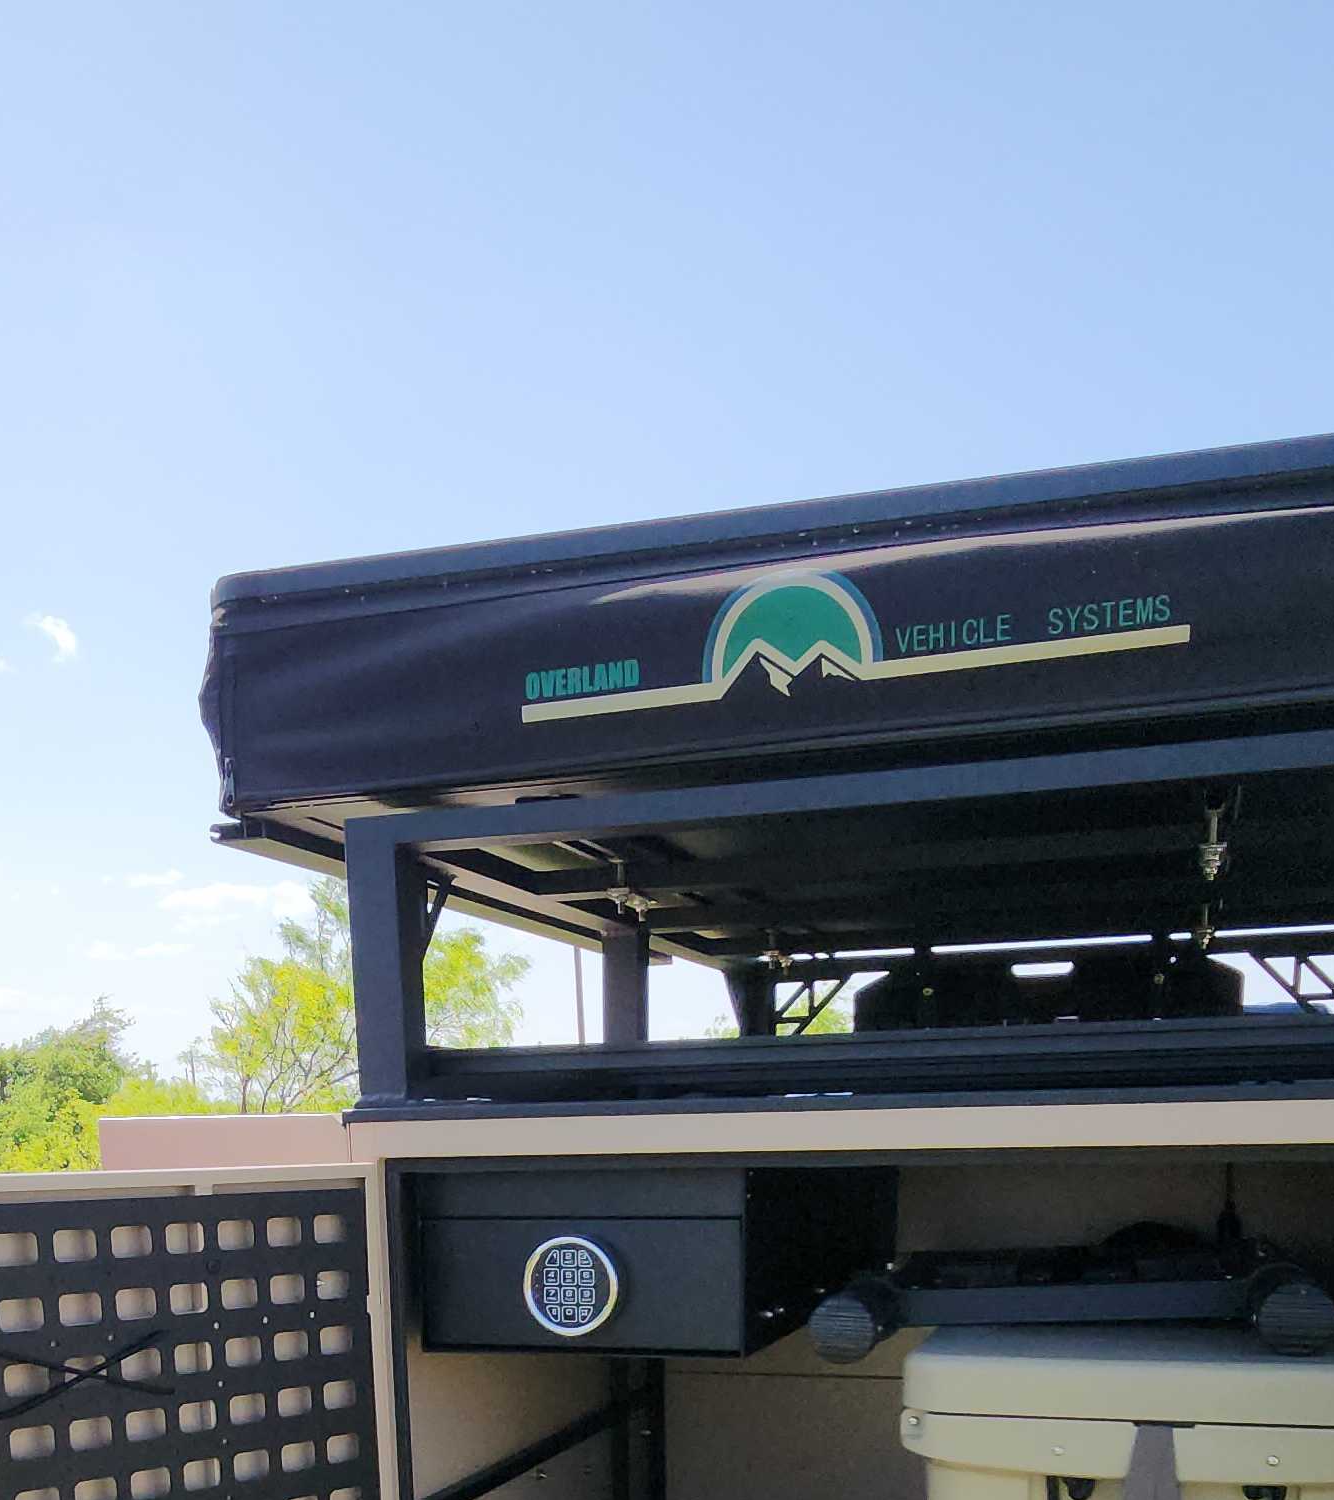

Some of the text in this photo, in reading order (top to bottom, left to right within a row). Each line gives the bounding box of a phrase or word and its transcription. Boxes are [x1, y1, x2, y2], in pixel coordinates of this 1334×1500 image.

[895, 594, 1172, 654] VEHICLE SYSTEMS
[525, 659, 640, 701] OVERLAND
